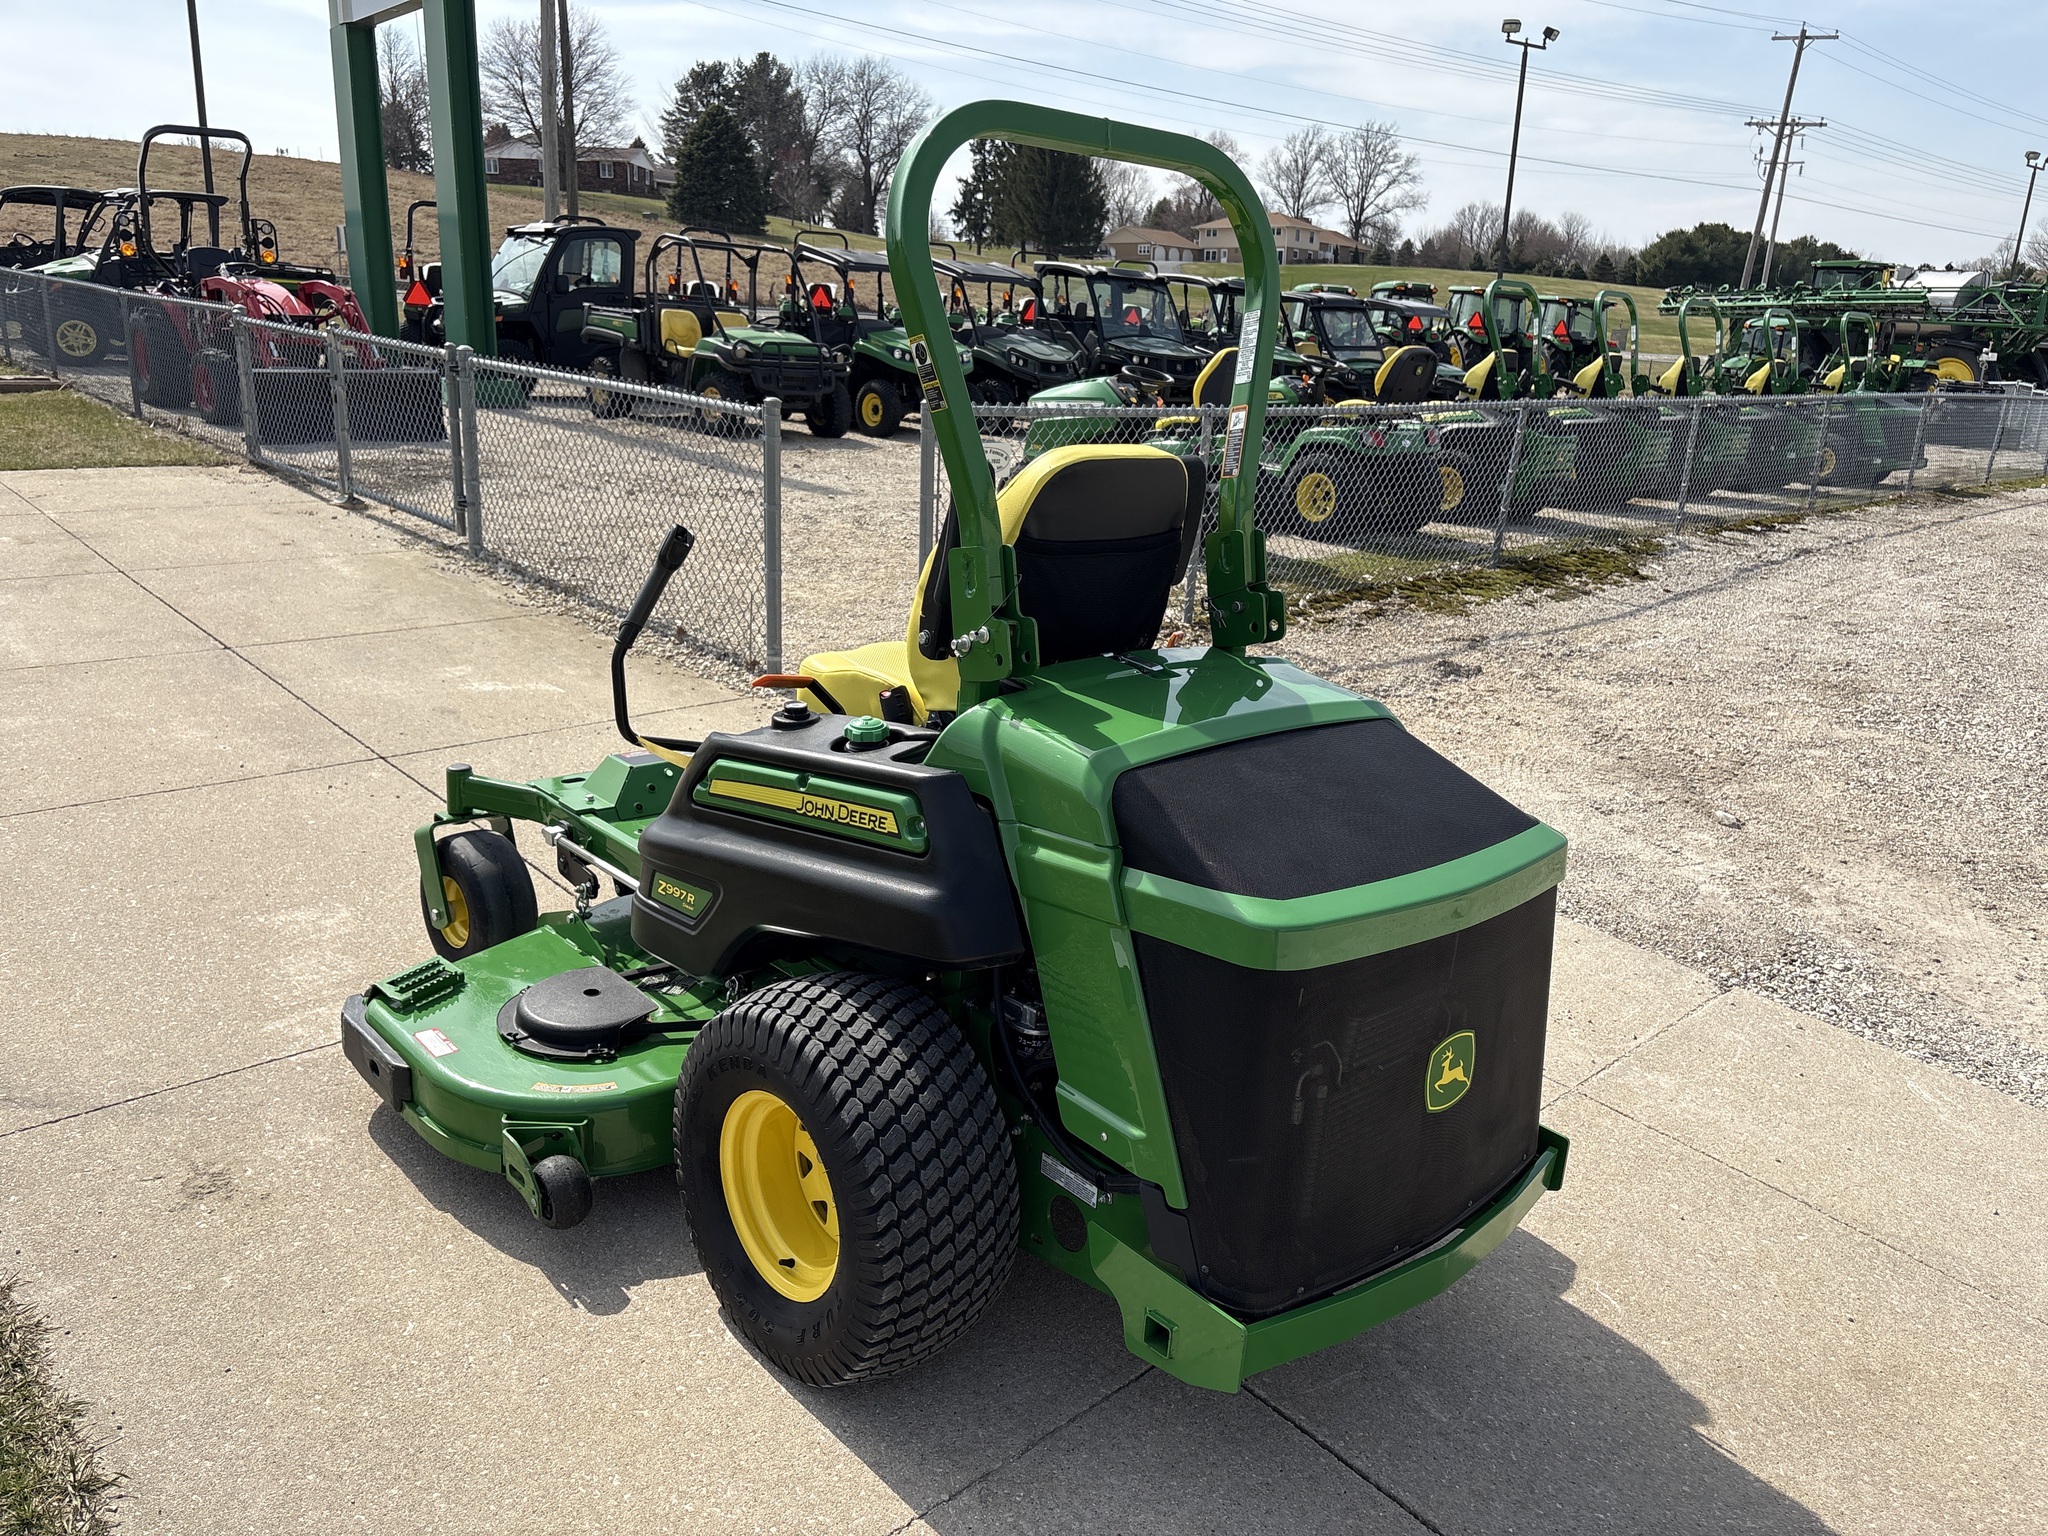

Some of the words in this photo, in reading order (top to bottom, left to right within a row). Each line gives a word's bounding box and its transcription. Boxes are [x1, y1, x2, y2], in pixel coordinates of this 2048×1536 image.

[796, 796, 835, 819] JOHN
[838, 804, 888, 831] DEERE
[657, 879, 695, 905] Z997R
[706, 1054, 768, 1081] KENDA
